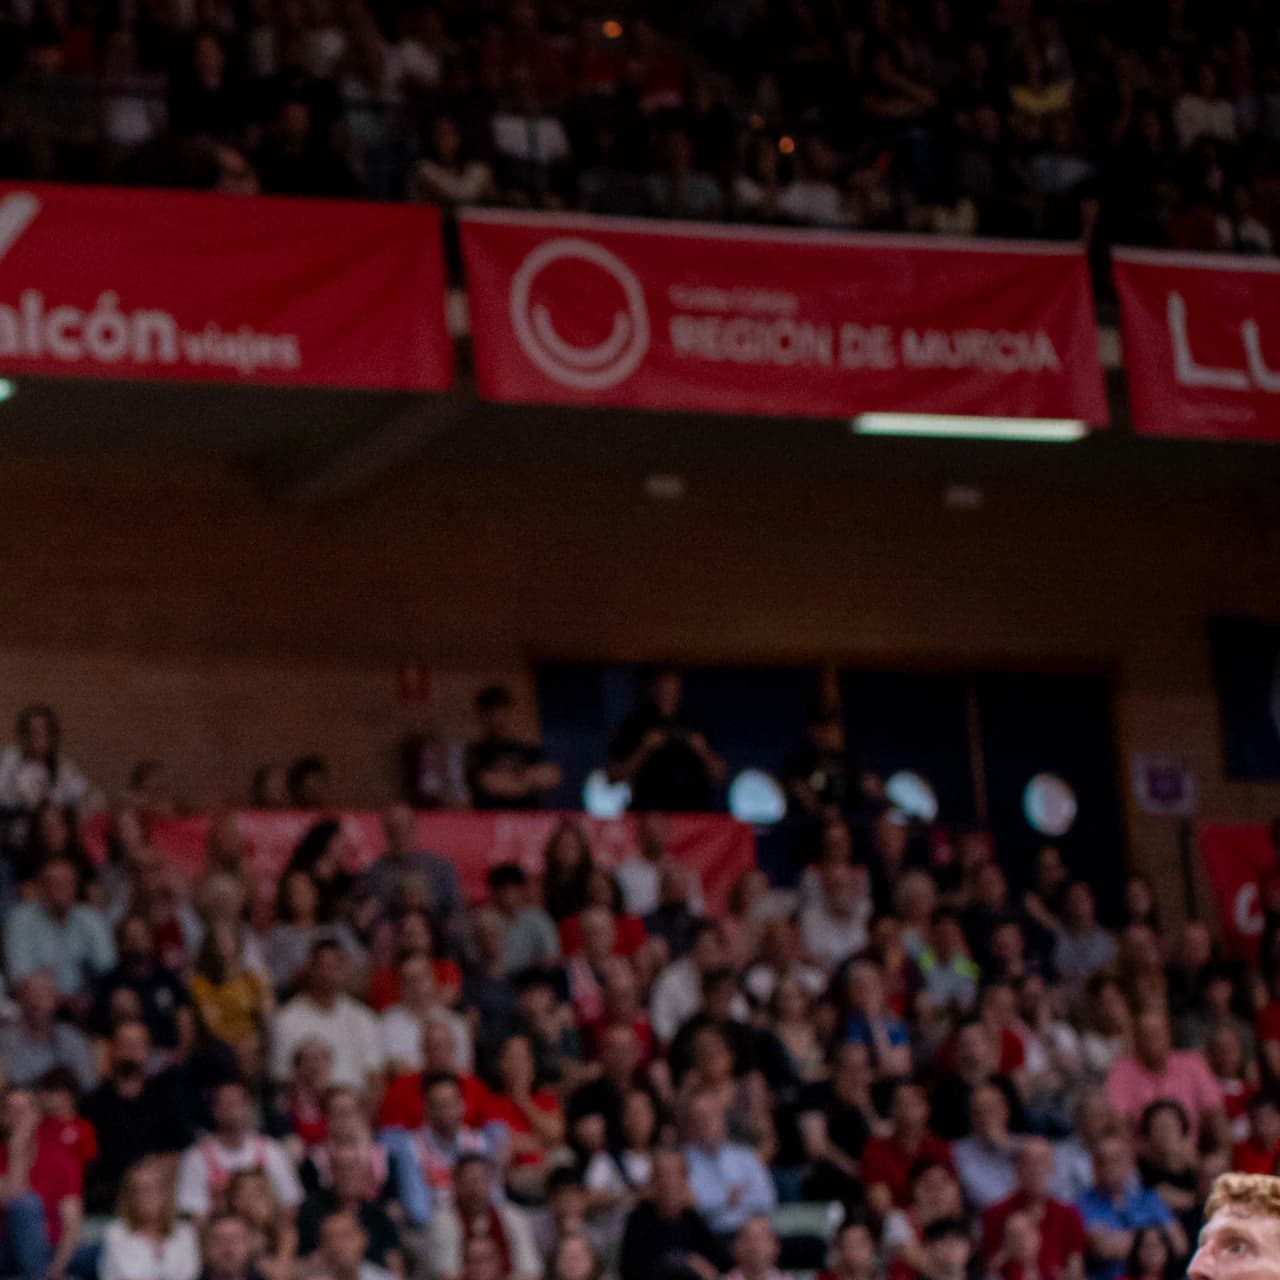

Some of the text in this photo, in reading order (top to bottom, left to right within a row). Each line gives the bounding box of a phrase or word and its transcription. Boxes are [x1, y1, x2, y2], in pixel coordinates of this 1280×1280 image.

[181, 322, 302, 374] viajes
[669, 314, 1063, 373] REGIÓN DE MURCIA
